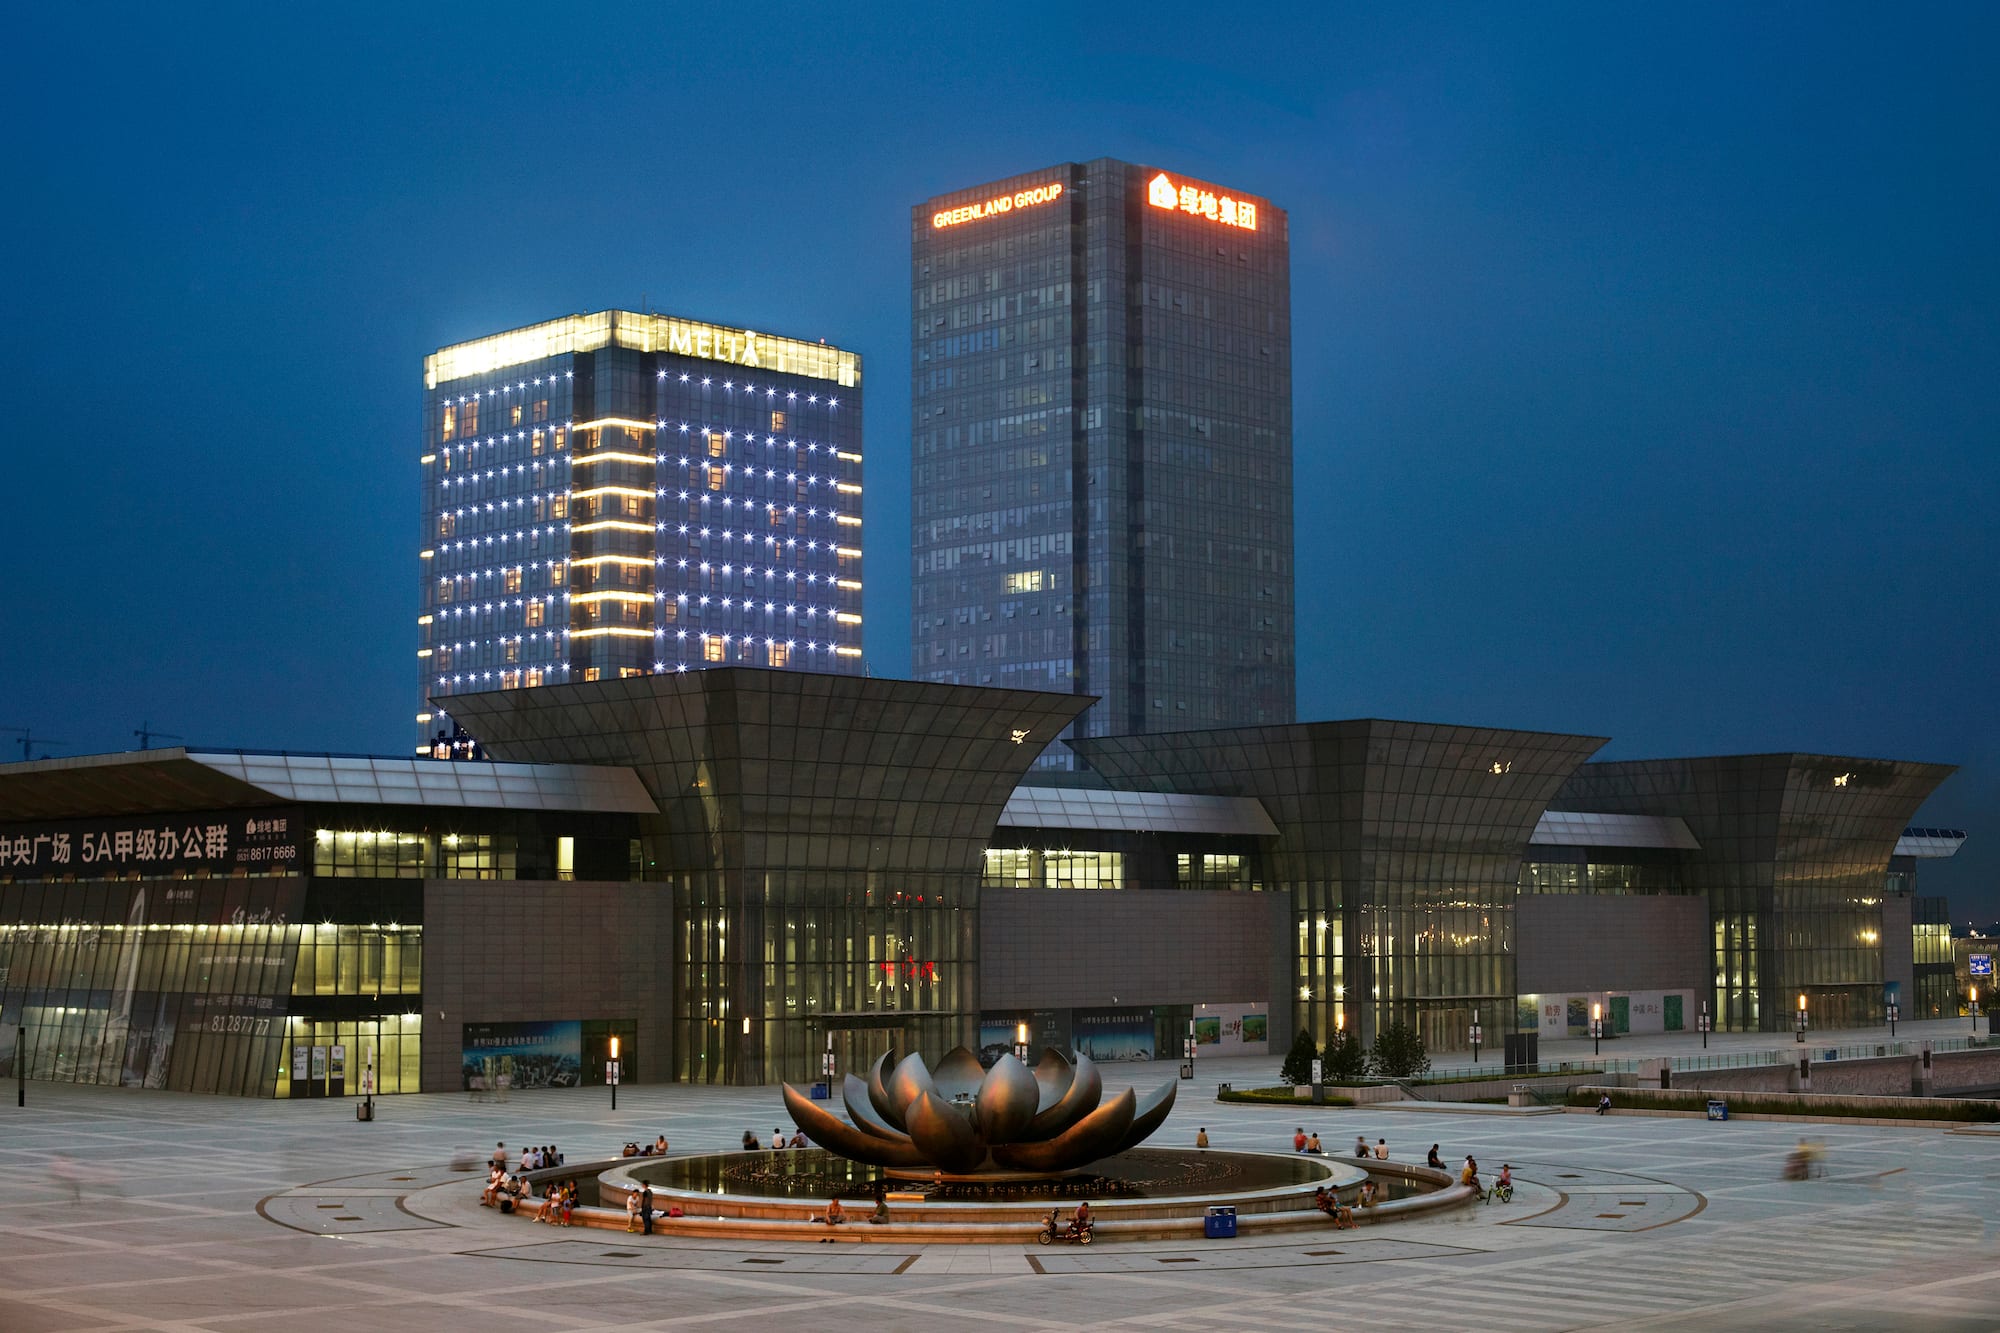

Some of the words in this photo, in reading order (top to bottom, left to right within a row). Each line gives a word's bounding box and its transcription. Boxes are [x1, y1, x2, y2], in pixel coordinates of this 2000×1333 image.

[933, 196, 1013, 228] GREENLAND
[1014, 183, 1062, 208] GROUP
[1179, 184, 1257, 231] 绿地集团
[82, 824, 228, 863] 5A甲级办公群
[250, 847, 272, 861] 8617
[273, 845, 296, 859] 6666
[211, 1015, 270, 1036] 81287777
